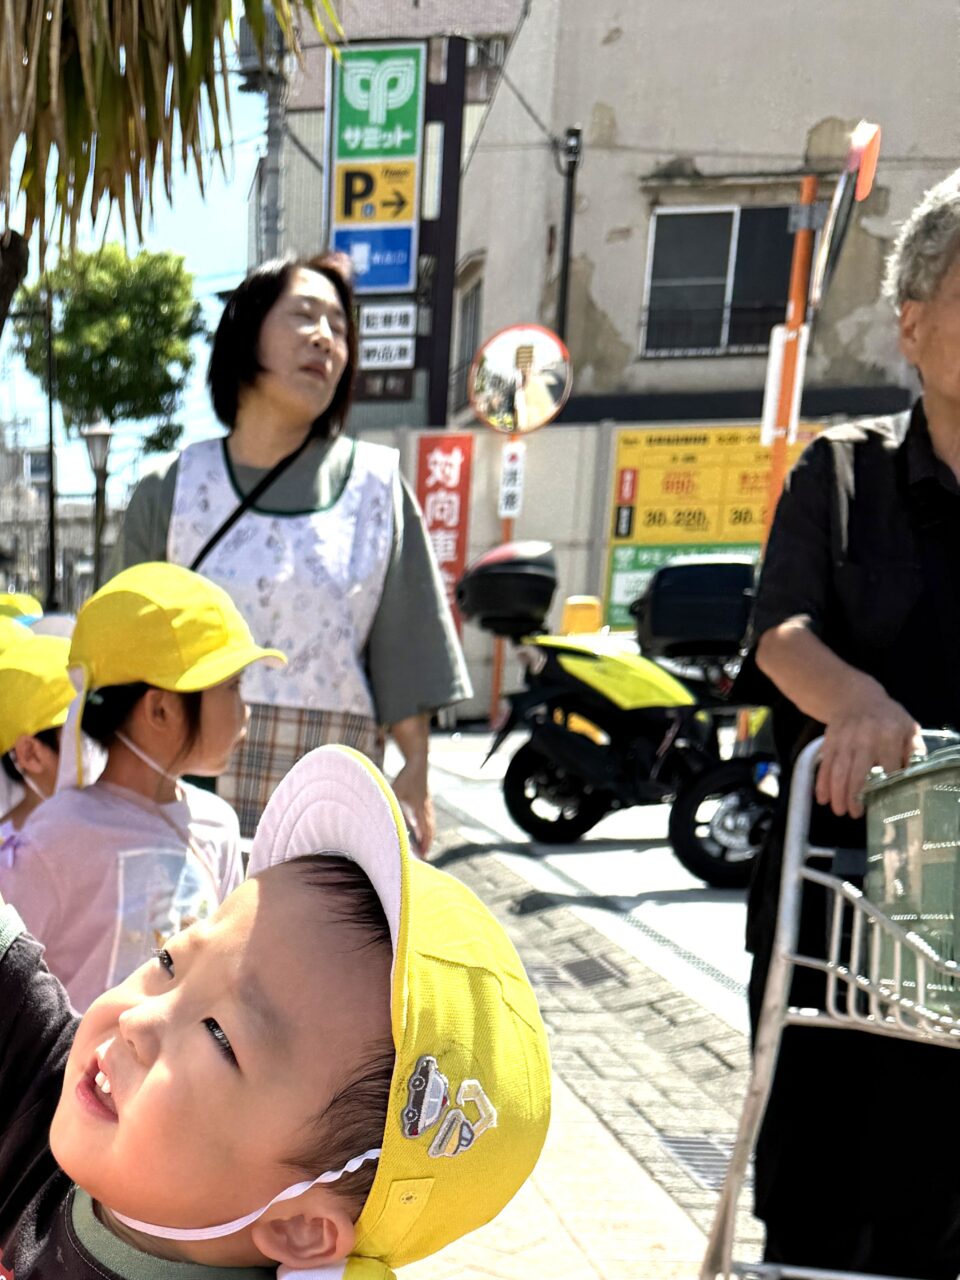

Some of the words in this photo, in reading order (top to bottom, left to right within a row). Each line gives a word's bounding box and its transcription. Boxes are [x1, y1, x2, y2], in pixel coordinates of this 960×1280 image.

[343, 124, 413, 149] サミット
[342, 170, 375, 218] P
